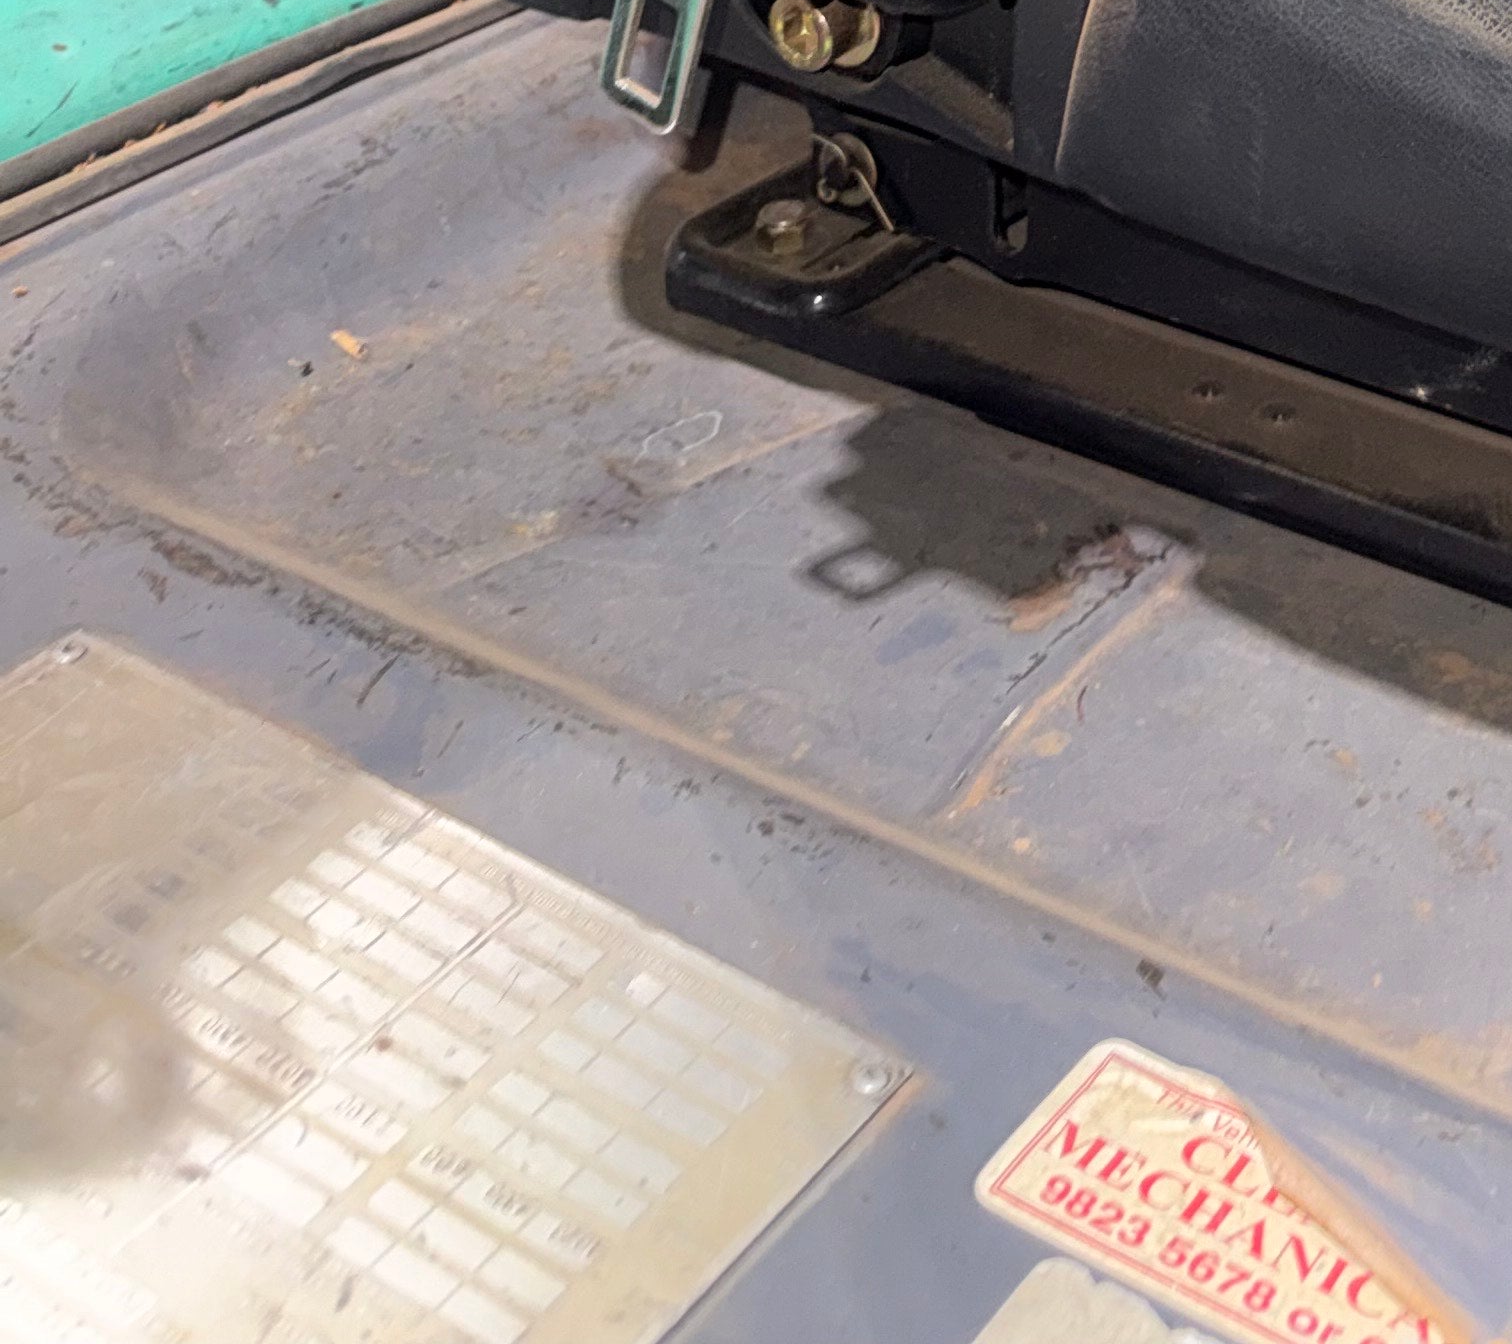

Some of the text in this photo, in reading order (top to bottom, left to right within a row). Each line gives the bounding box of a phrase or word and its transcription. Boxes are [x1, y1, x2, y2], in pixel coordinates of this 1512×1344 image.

[1039, 1174, 1344, 1344] 9823 5678 or
